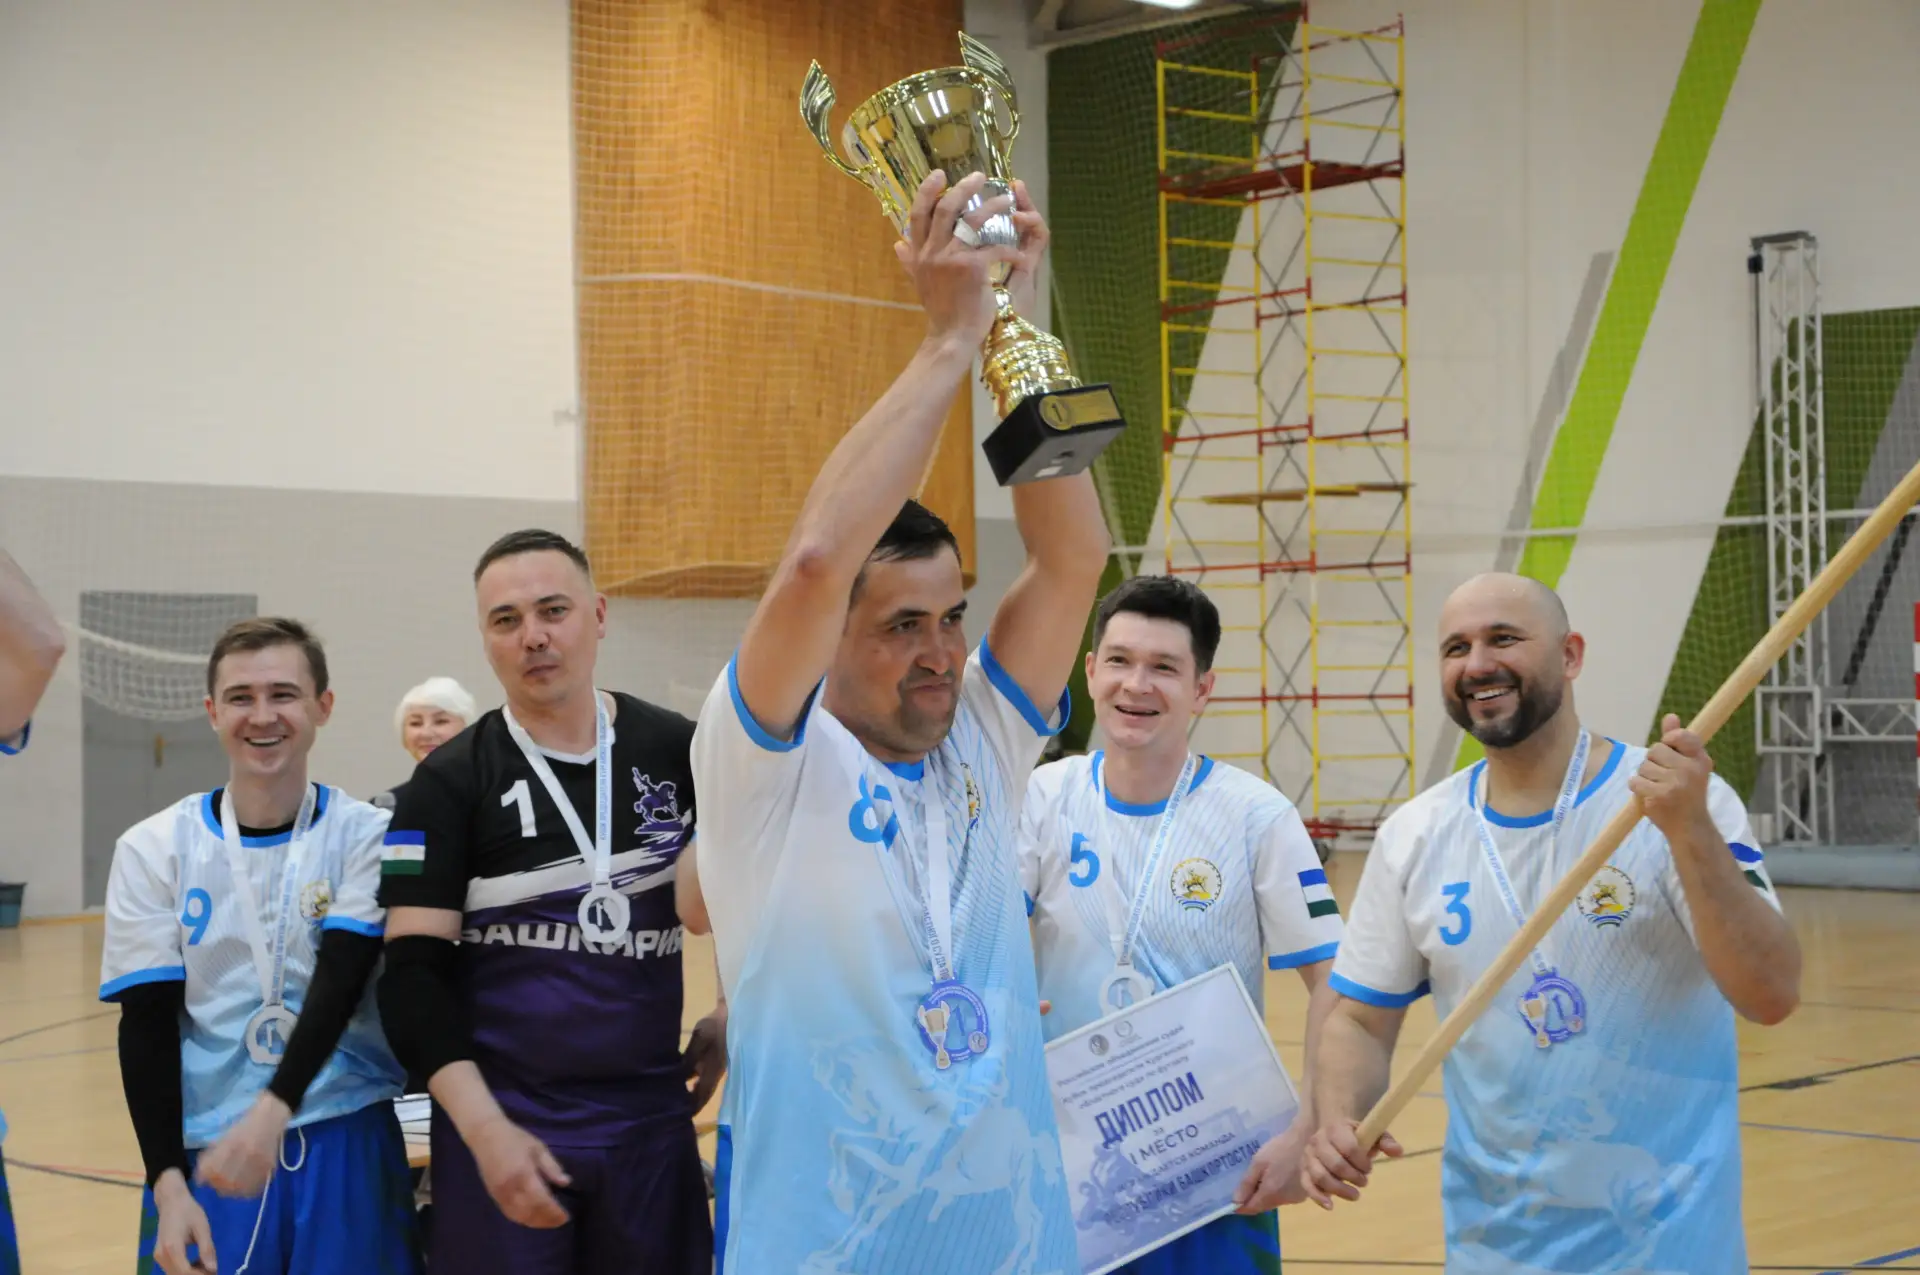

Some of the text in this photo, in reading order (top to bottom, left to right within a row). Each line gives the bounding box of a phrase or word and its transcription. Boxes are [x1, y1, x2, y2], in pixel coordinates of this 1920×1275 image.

[501, 779, 537, 837] 1
[1068, 832, 1101, 888] 5
[181, 887, 212, 945] 9
[1440, 881, 1472, 946] 3
[1094, 1071, 1204, 1149] ДИПЛОМ
[1139, 1124, 1199, 1161] МЕСТО
